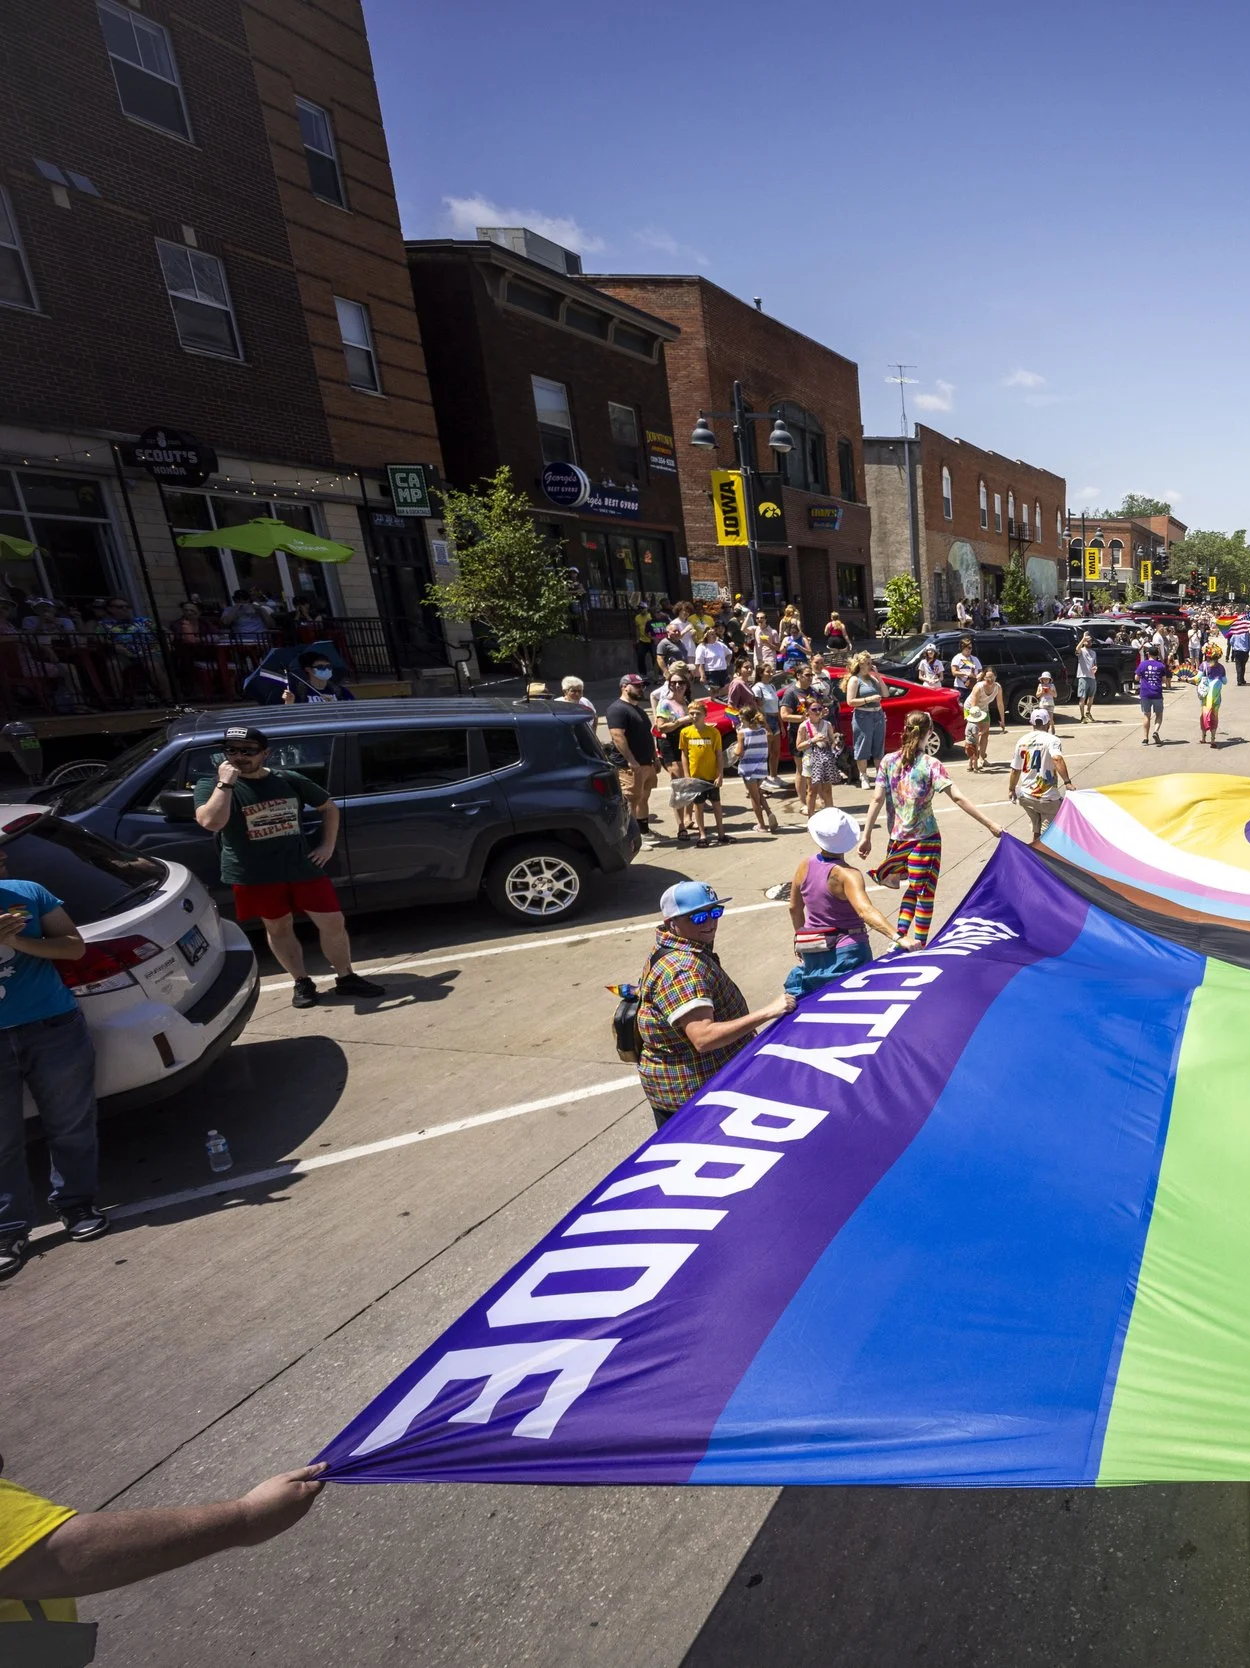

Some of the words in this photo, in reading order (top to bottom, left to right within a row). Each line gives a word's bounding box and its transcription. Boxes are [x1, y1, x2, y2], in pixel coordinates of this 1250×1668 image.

[135, 448, 198, 464] SCOUT'S
[153, 465, 187, 476] HONOR
[395, 472, 420, 487] CA
[397, 488, 422, 503] MP
[604, 498, 619, 508] BEST
[620, 500, 639, 511] GYROS
[720, 480, 740, 537] IOWA
[1088, 551, 1096, 575] IOWA
[754, 966, 943, 1084] CITY
[349, 1089, 829, 1457] PRIDE
